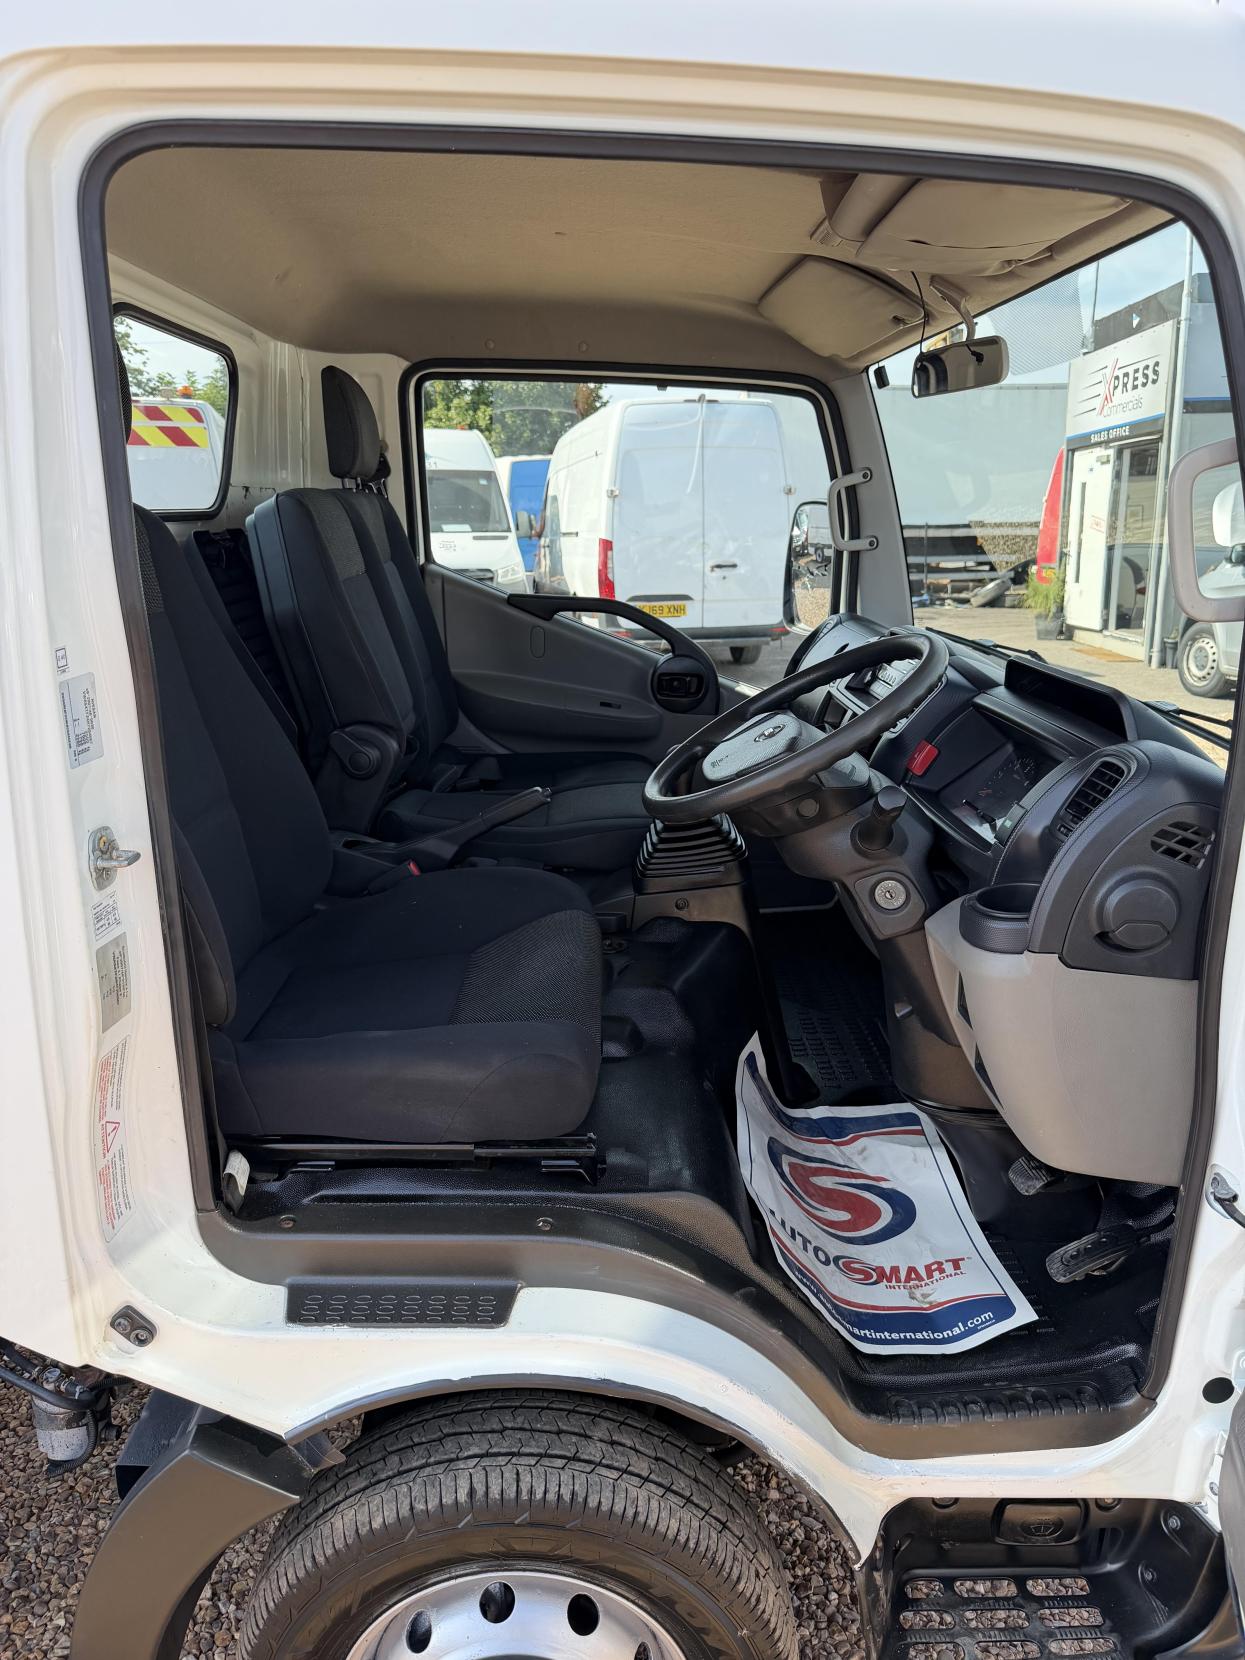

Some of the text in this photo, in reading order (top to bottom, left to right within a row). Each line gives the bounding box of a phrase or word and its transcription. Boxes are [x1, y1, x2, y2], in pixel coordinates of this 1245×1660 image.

[1090, 425, 1130, 443] SALES OFFICE
[666, 603, 687, 616] XNH
[769, 1207, 966, 1287] UTOSMART
[884, 1270, 967, 1291] INTERNATIONAL
